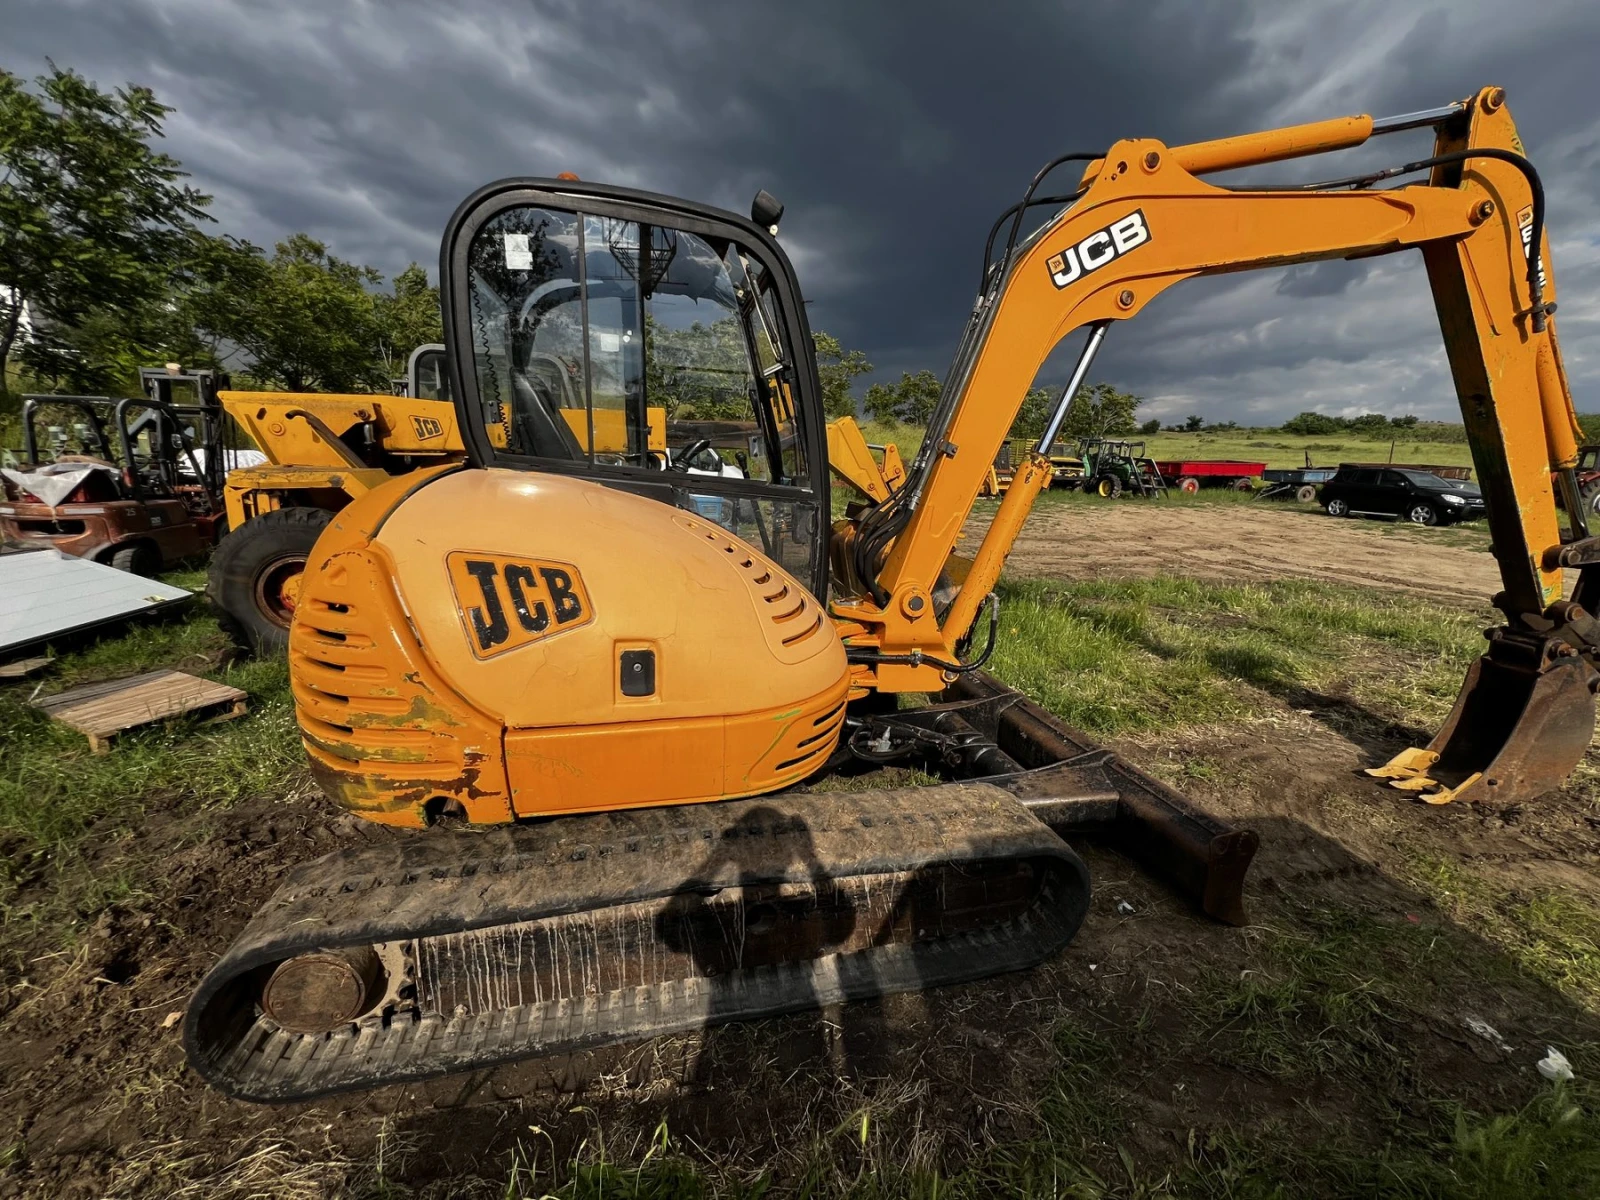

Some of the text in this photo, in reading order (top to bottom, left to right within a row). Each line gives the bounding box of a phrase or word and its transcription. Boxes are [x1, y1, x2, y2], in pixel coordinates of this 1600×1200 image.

[1053, 212, 1148, 286] JCB
[413, 417, 441, 438] JCB
[465, 560, 583, 651] JCB
